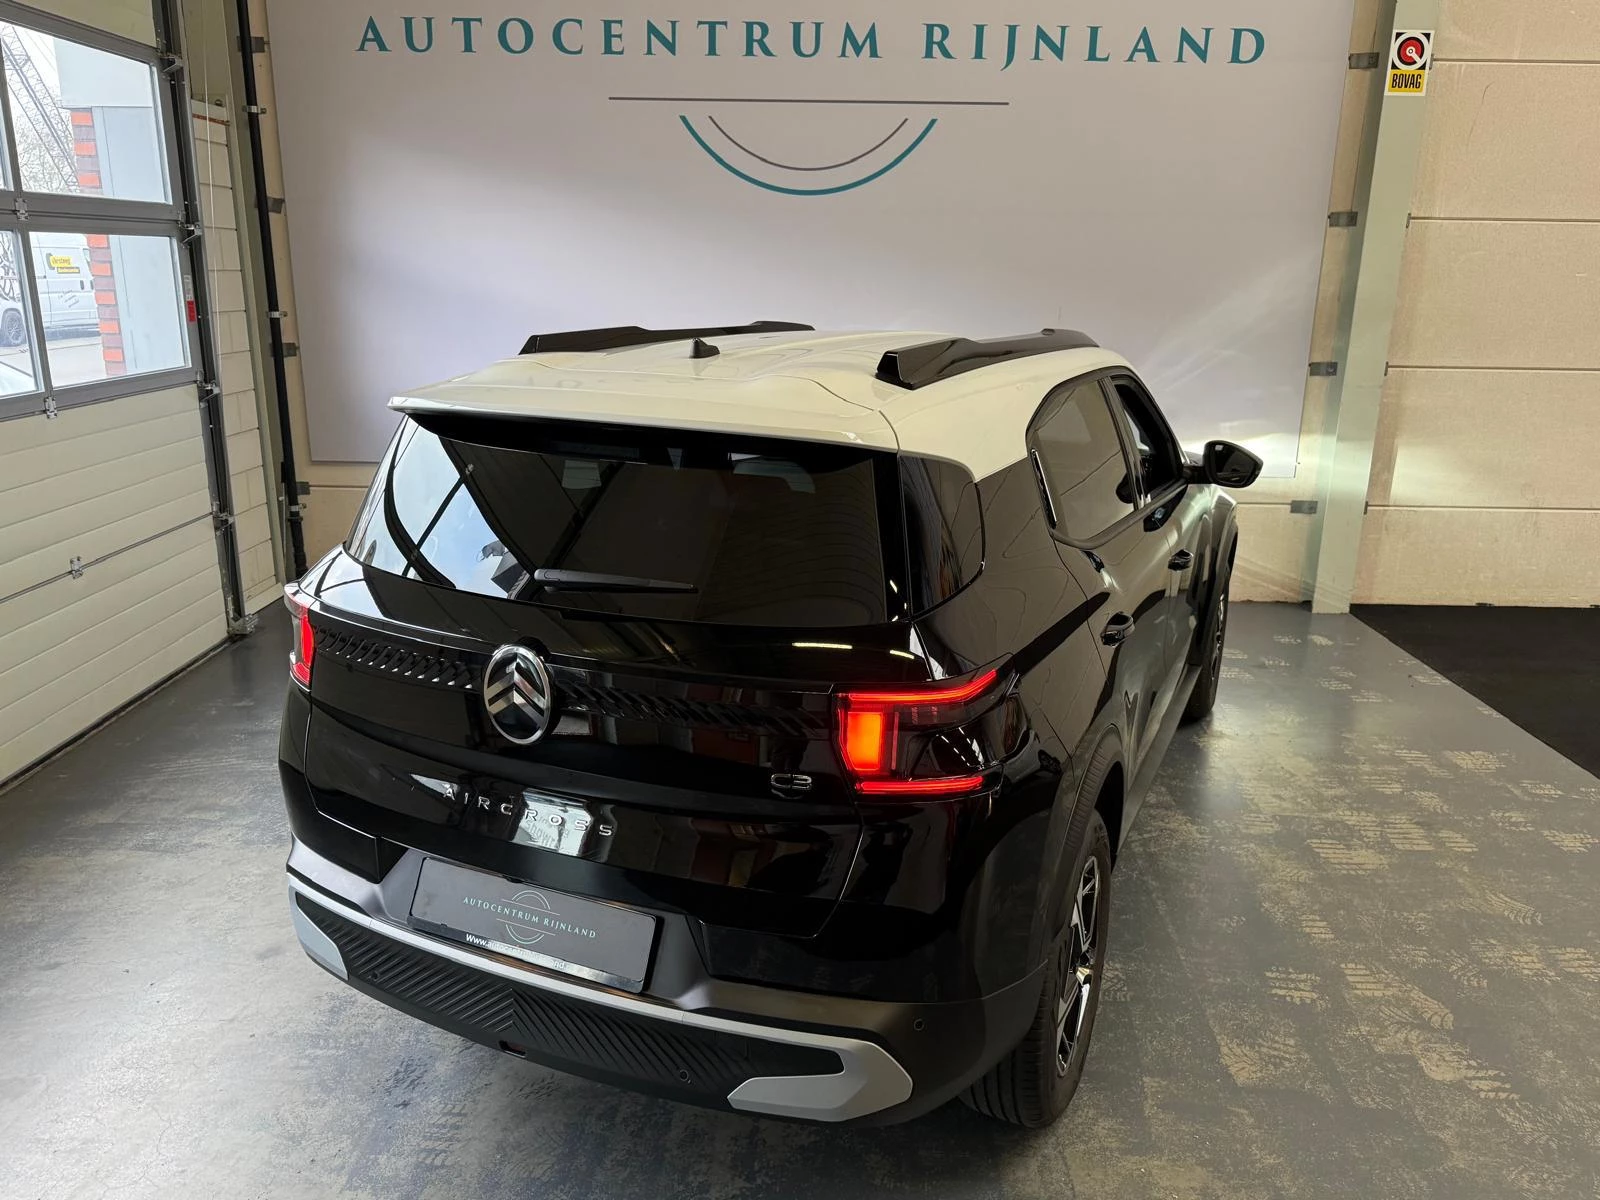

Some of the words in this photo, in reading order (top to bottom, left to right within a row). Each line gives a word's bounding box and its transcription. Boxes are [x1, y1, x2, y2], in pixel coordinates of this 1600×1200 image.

[354, 15, 882, 59] AUTOCENTRUM
[921, 22, 1266, 71] RIJNLAND
[1391, 73, 1422, 89] BOVAG
[442, 787, 614, 836] AIRCROSS
[463, 896, 540, 924] AUTOCENTRUM
[543, 916, 597, 939] RIJNLAND
